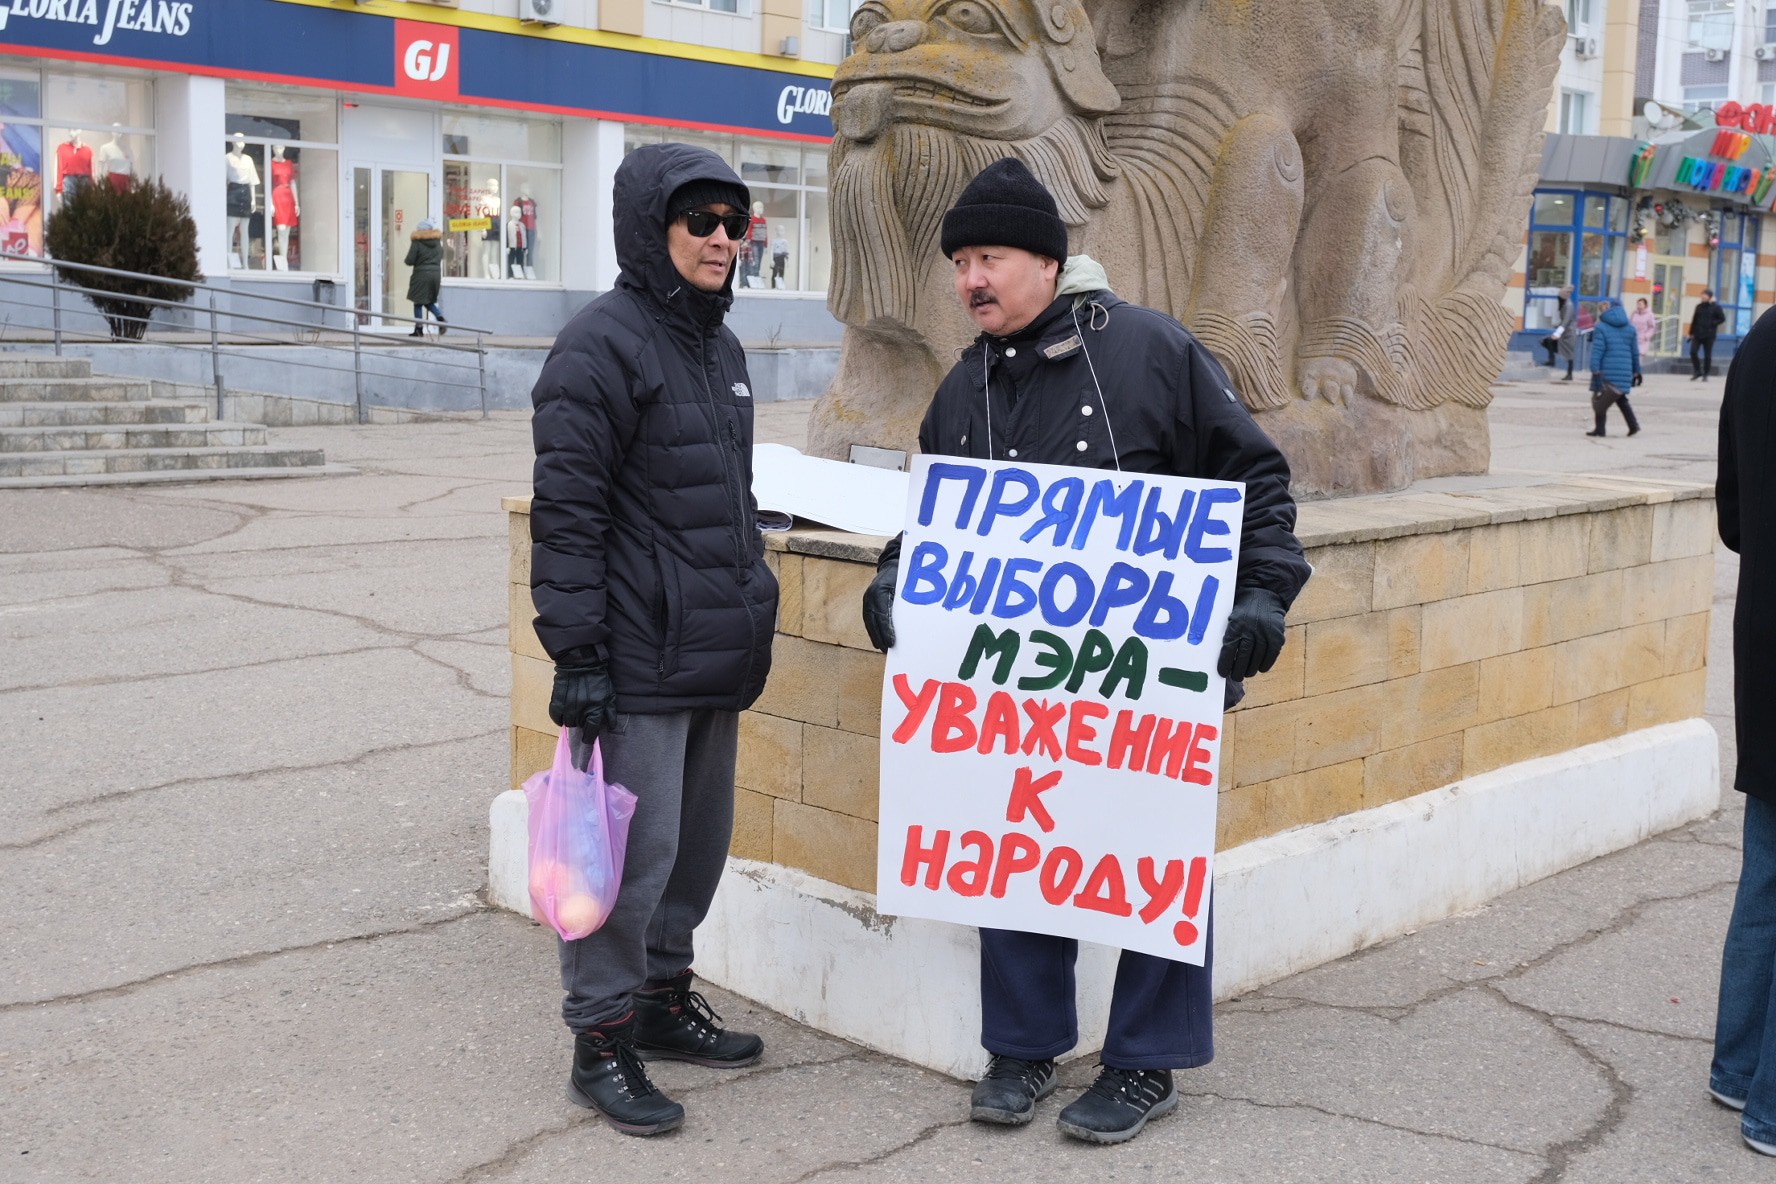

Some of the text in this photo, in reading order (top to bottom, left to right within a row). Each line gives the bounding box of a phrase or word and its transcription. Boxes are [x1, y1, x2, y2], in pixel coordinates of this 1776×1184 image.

[93, 0, 193, 45] JEANS
[404, 39, 450, 81] GJ
[475, 206, 500, 217] YOU
[919, 463, 1241, 563] ПРЯМЫЕ
[901, 542, 1219, 645] ВЫБОРЫ
[958, 624, 1148, 700] МЭРА
[892, 673, 1218, 786] УВАЖЕНИЕ
[1006, 767, 1063, 833] К
